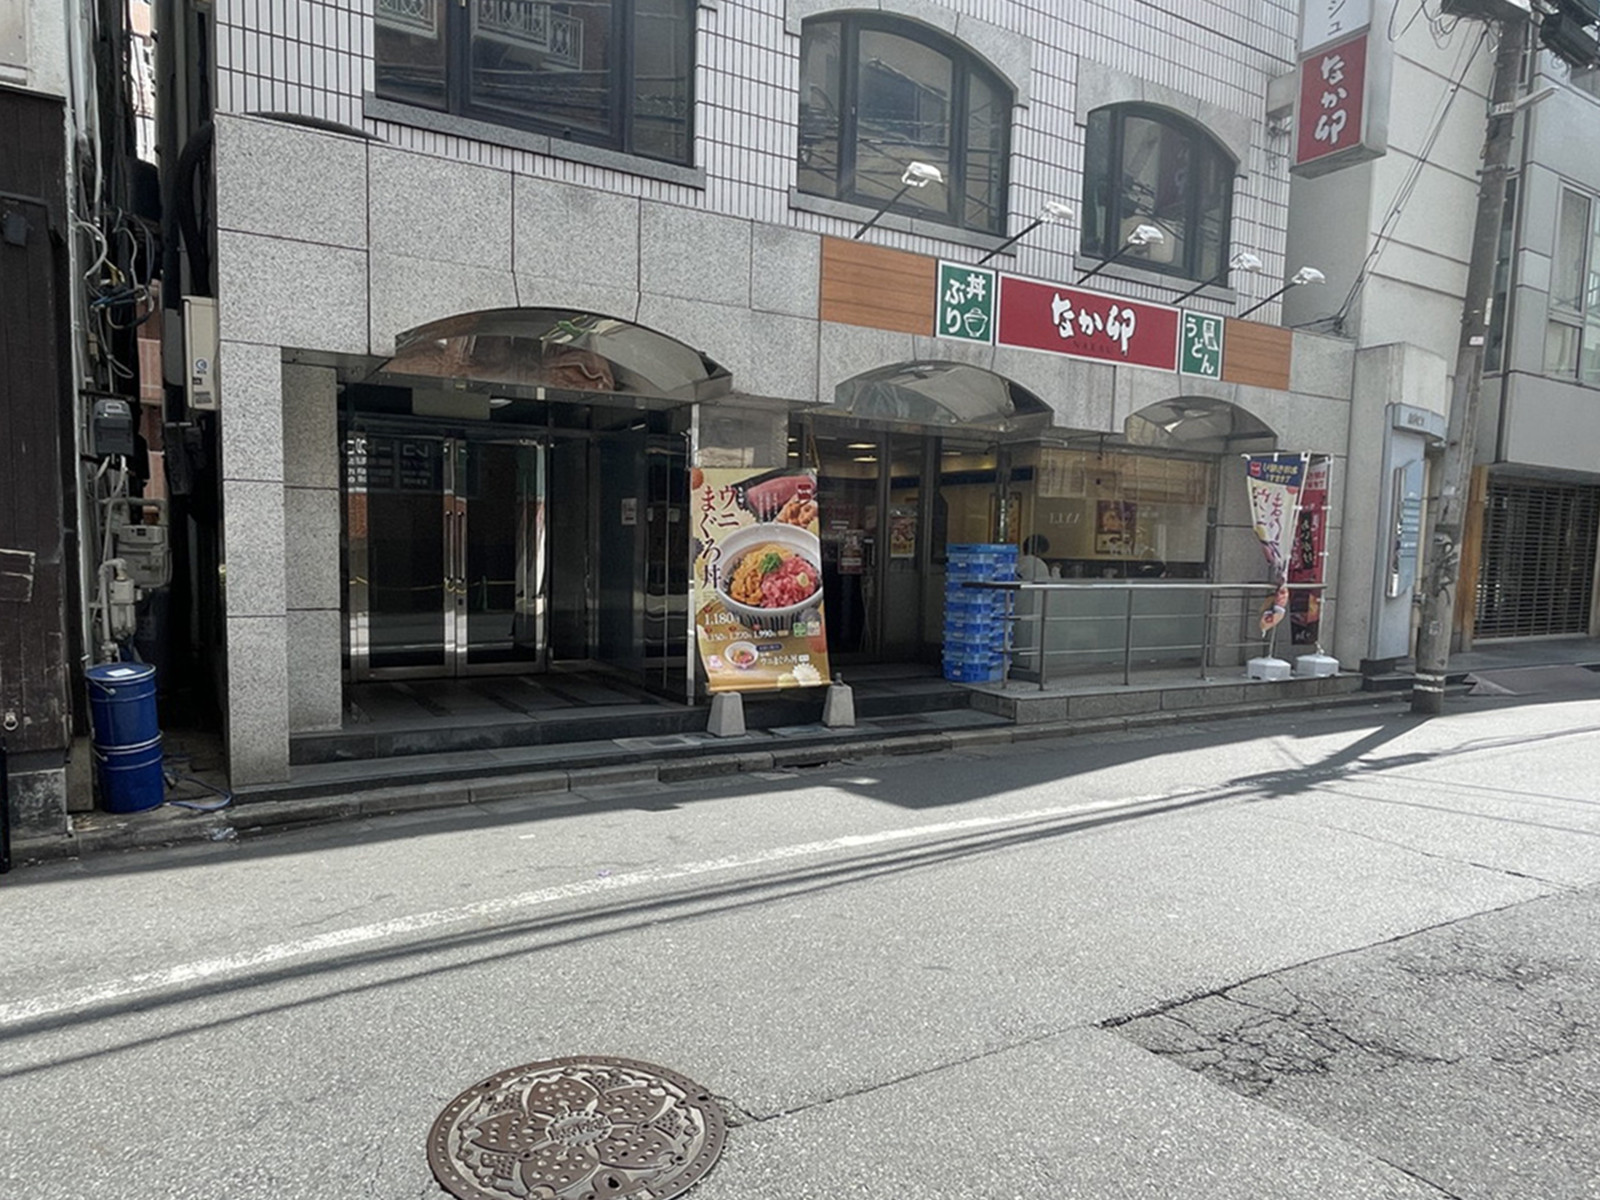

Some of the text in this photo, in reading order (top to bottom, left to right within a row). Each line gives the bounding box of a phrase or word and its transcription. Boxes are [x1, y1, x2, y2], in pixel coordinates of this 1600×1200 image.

[1314, 54, 1348, 145] なか卯
[1051, 293, 1137, 356] なか卯
[1186, 316, 1214, 374] うどん
[718, 485, 739, 526] ウニ
[700, 487, 722, 589] まぐろ丼
